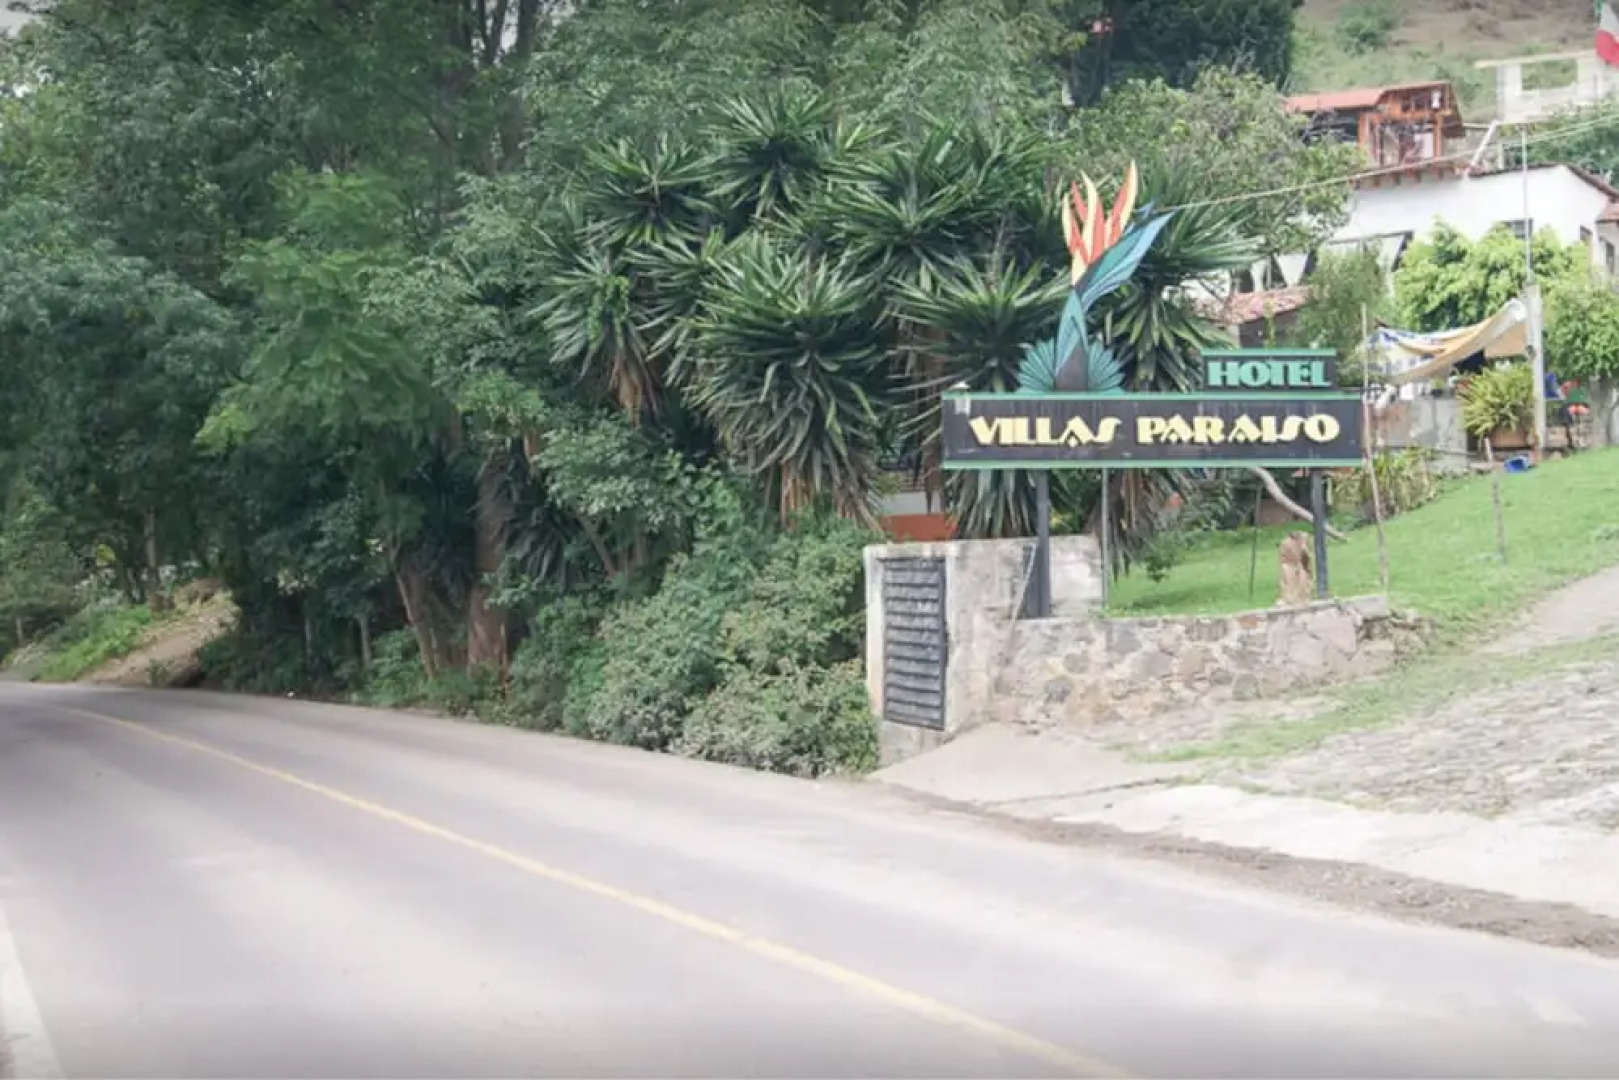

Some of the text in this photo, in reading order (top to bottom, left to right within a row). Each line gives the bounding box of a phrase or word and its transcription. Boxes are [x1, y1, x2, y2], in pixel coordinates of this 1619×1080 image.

[1208, 361, 1331, 388] HOTEL
[969, 413, 1340, 447] VILLAS PARAISO
